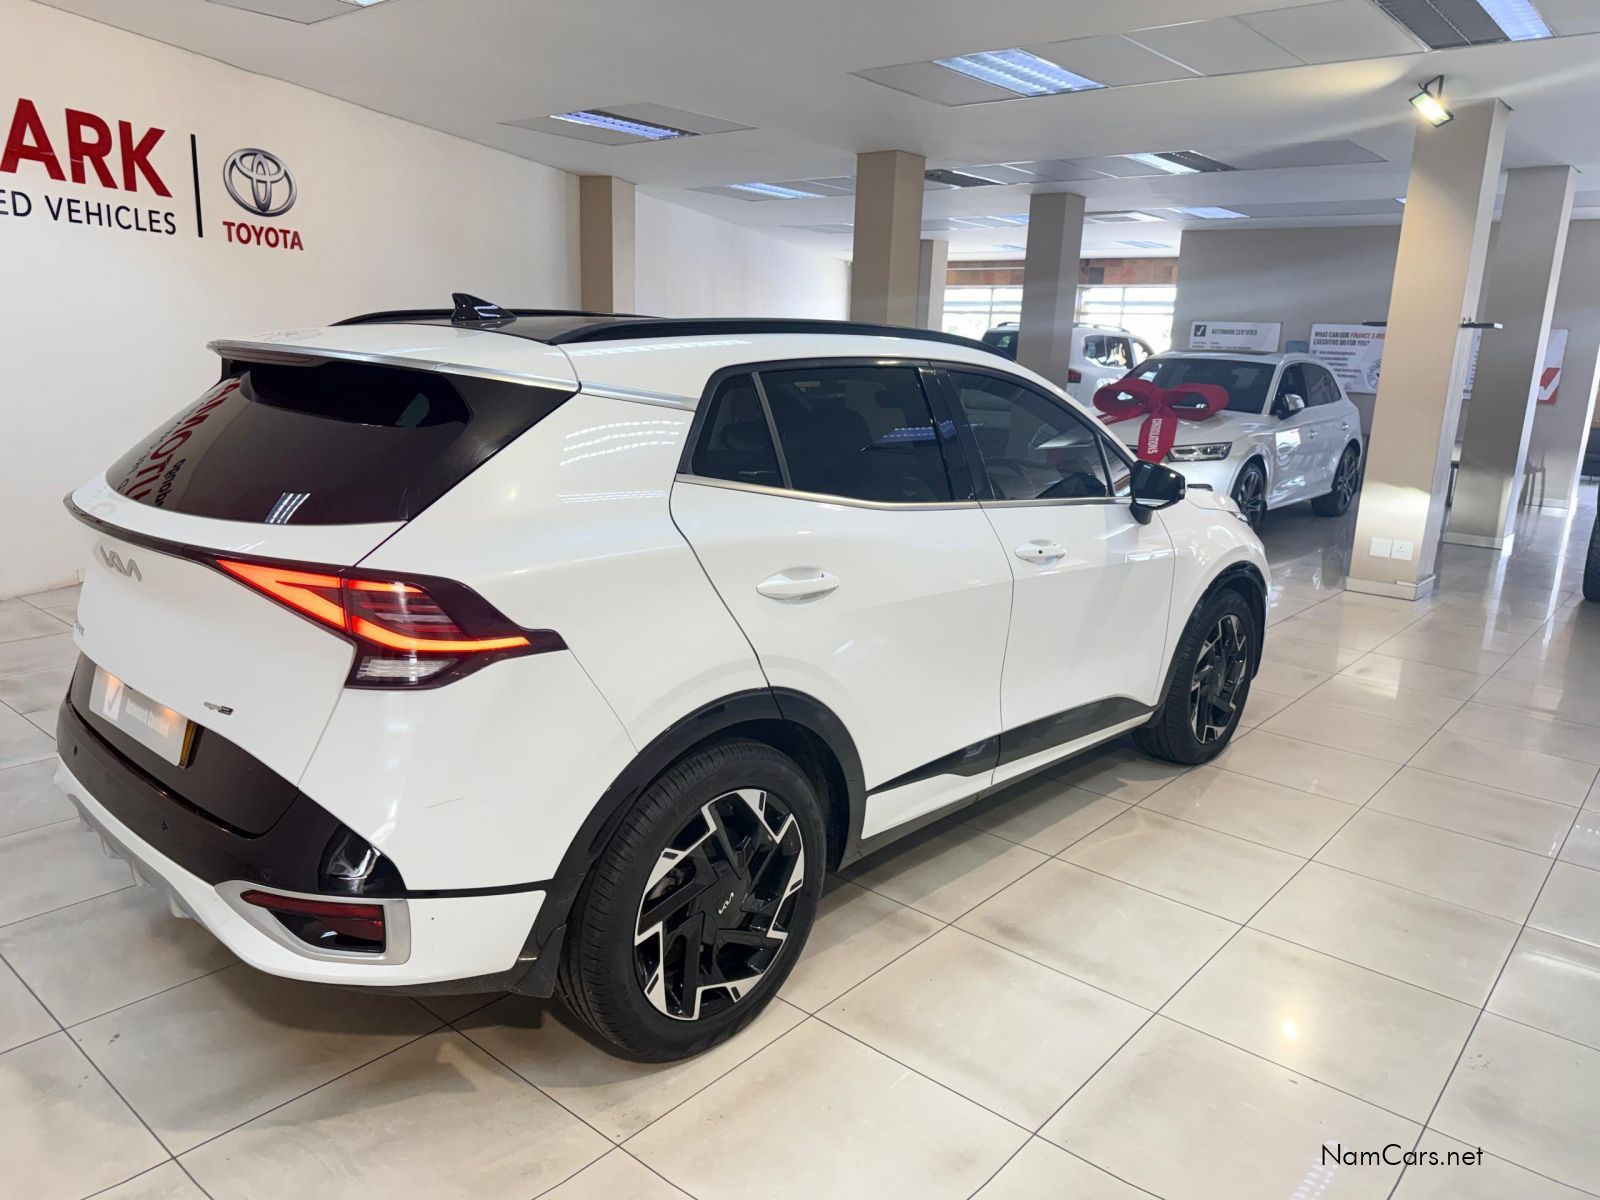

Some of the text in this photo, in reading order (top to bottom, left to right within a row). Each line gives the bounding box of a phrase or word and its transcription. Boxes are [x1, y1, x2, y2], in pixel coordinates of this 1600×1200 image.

[0, 98, 173, 198] ARK
[44, 194, 177, 235] VEHICLES
[222, 220, 304, 251] TOYOTA
